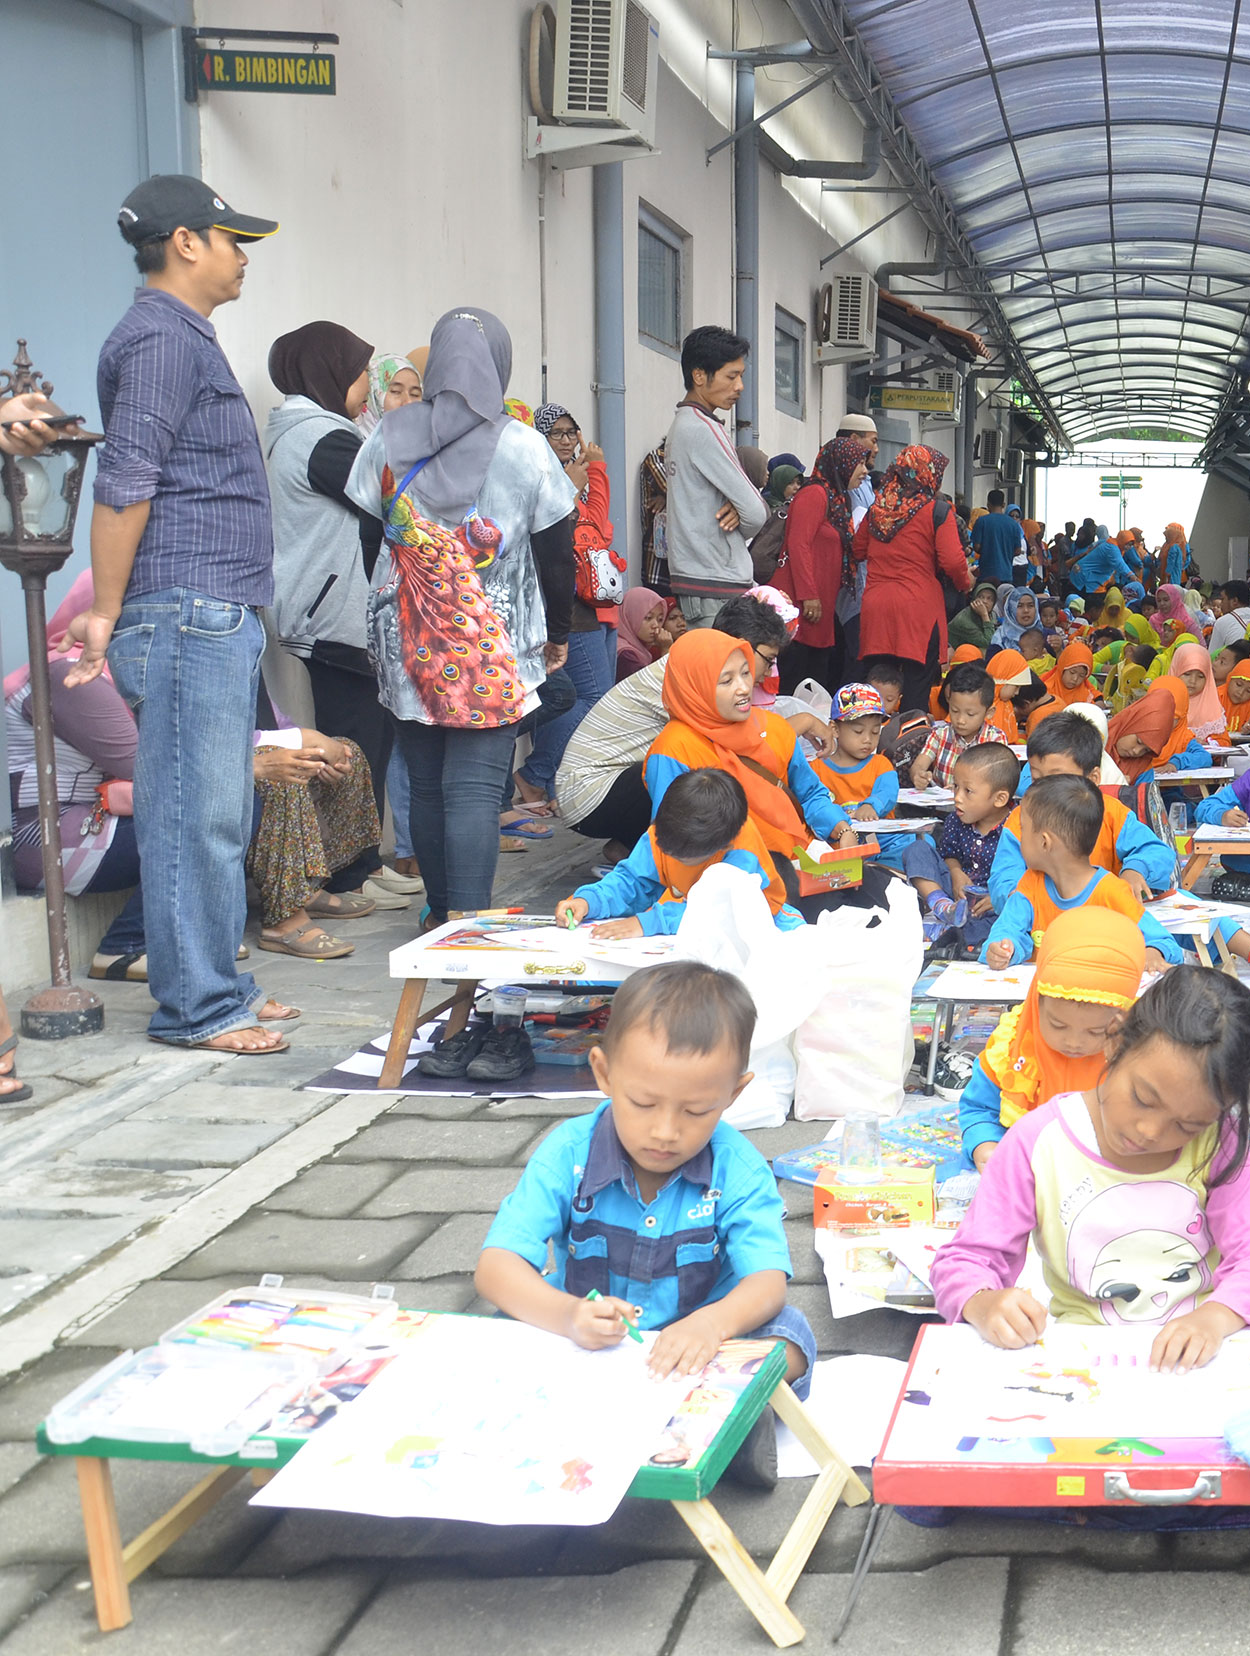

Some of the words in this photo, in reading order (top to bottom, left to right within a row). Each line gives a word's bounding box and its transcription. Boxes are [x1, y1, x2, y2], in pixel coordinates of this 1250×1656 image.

[214, 55, 230, 81] R.
[235, 56, 330, 85] BIMBINGAN
[897, 394, 950, 403] PERPUSTAKAAN
